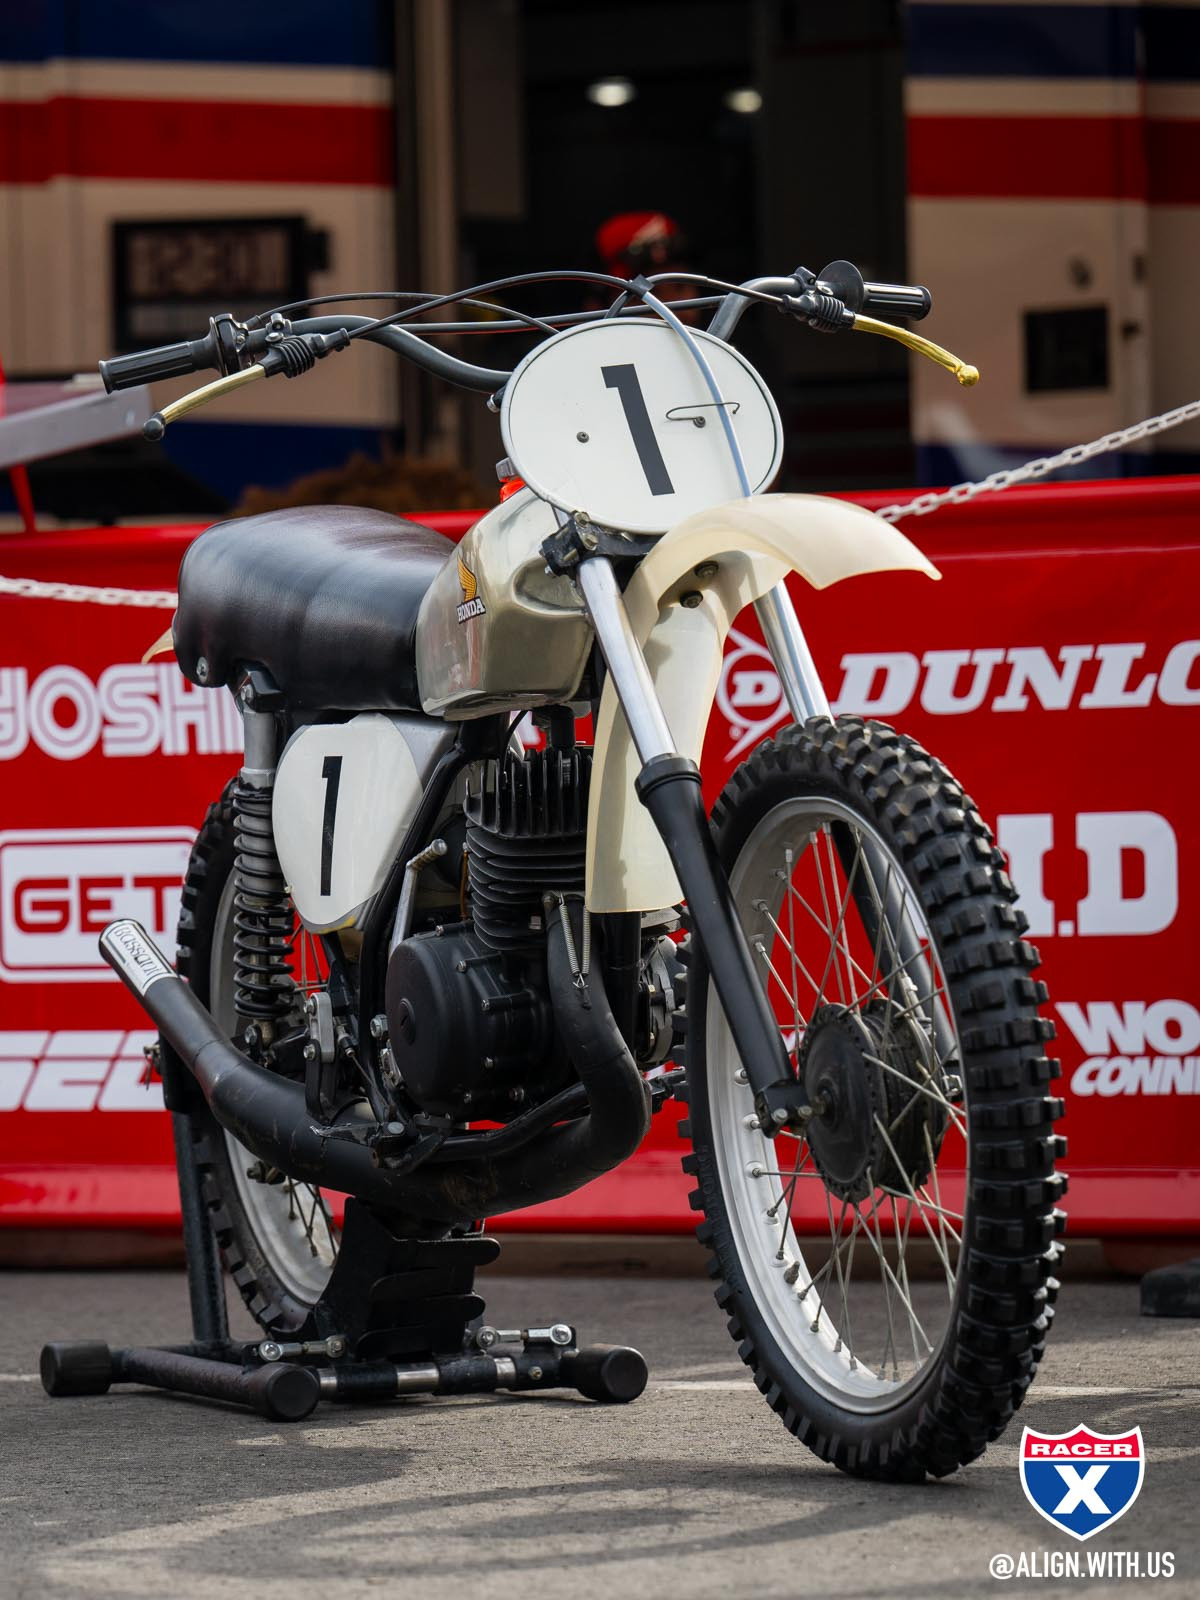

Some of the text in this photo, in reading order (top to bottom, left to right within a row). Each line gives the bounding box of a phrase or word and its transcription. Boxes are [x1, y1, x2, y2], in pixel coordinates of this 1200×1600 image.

[600, 363, 676, 497] 1
[457, 597, 485, 622] HONDA
[320, 756, 343, 896] 1
[14, 876, 185, 933] GET
